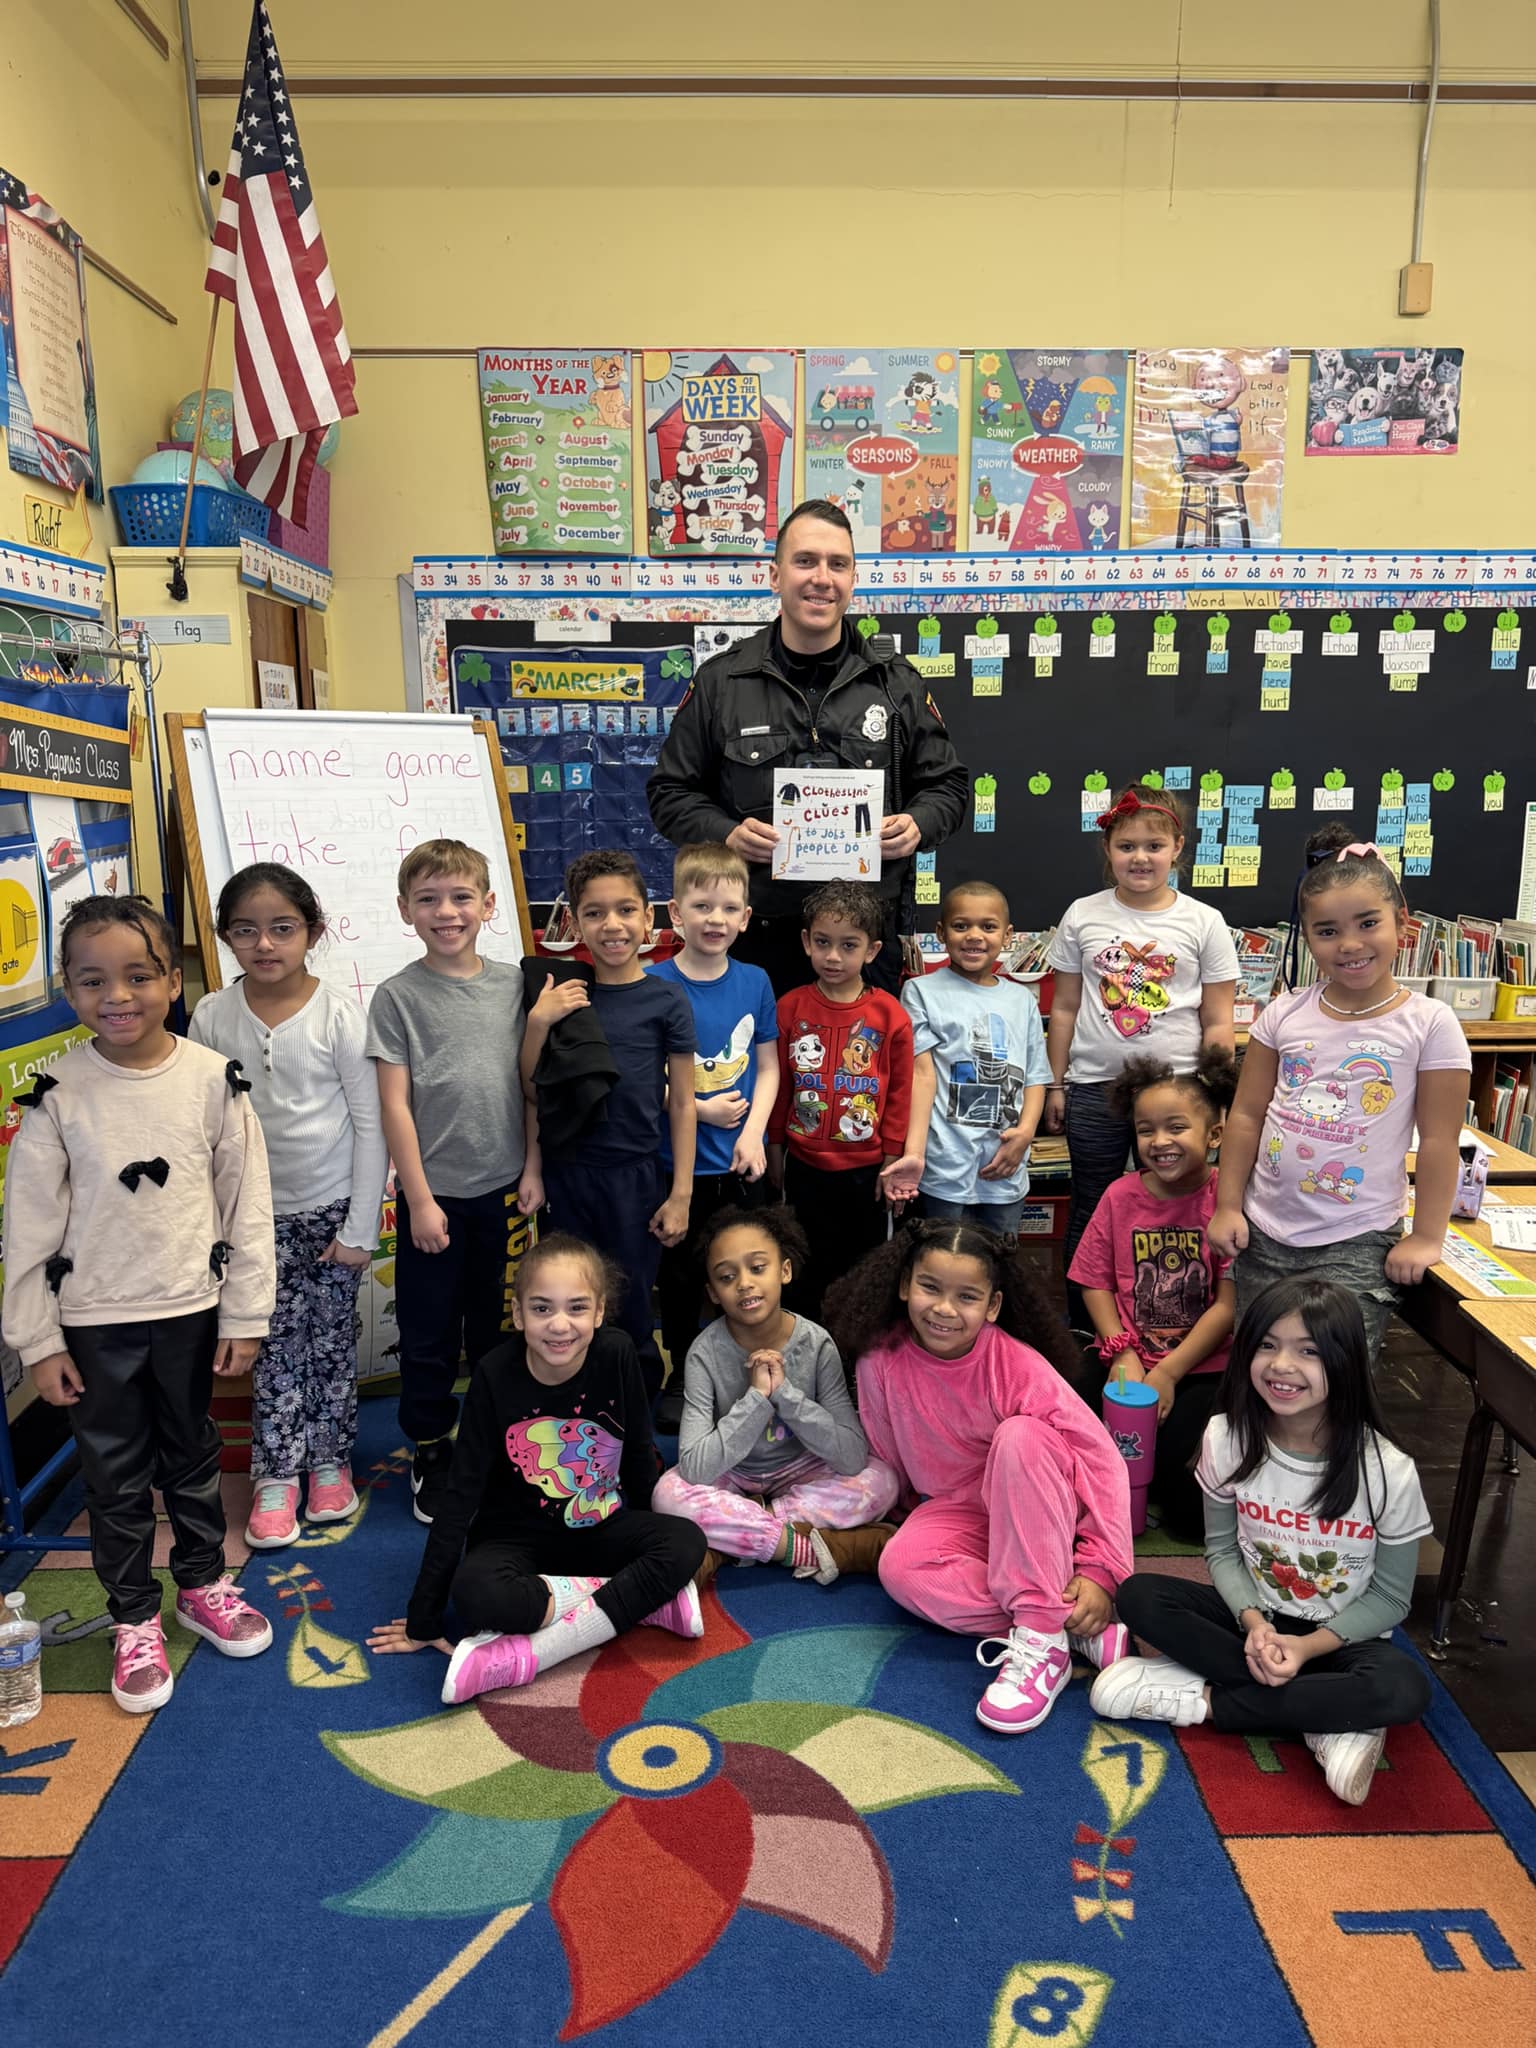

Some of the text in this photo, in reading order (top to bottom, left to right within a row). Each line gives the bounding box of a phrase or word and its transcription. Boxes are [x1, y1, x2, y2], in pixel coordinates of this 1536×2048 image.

[484, 355, 589, 371] MONTHS OF THE
[811, 356, 845, 367] SPRING
[888, 356, 929, 367] SUMMER
[1037, 356, 1071, 367] STORMY
[532, 375, 586, 395] YEAR
[687, 379, 736, 397] DAYS
[486, 392, 529, 404] January
[685, 395, 757, 420] WEEK
[492, 413, 541, 426] February
[564, 435, 607, 446] August
[700, 431, 743, 444] Sunday
[987, 428, 1015, 438] SUNNY
[491, 435, 526, 448] March
[1091, 441, 1115, 450] RAINY
[504, 455, 532, 468] April
[559, 456, 617, 468] September
[687, 448, 734, 464] Monday
[853, 447, 912, 464] SEASONS
[1019, 447, 1077, 463] WEATHER
[707, 464, 754, 477] Tuesday
[810, 459, 844, 470] WINTER
[931, 459, 951, 469] FALL
[978, 459, 1008, 469] SNOWY
[495, 481, 520, 495] May
[563, 477, 612, 489] October
[1079, 483, 1110, 493] CLOUDY
[687, 485, 741, 499] Wednesday
[506, 506, 534, 516] June
[560, 502, 617, 512] November
[713, 500, 760, 513] Thursday
[32, 503, 62, 548] Right
[699, 518, 734, 531] Friday
[500, 530, 520, 542] July
[559, 528, 620, 540] December
[710, 533, 758, 546] Saturday
[6, 567, 76, 597] 14 15 16 17 18
[420, 574, 765, 586] 33 34 35 36 37 38 39 40 41 42 43 44 45 46 47
[870, 567, 1517, 583] 52 53 54 55 56 57 58 59 60 61 62 63 64 65 66 67 68 69 70 71 72 73 74 75 76 77 78 79
[1187, 592, 1226, 608] Word
[1243, 592, 1278, 607] Wall
[174, 621, 201, 642] flag
[1031, 637, 1061, 654] David
[1157, 635, 1171, 653] for
[1149, 655, 1178, 672] from
[1493, 651, 1514, 667] look
[534, 671, 616, 692] MARCH
[9, 727, 41, 773] Mrs.
[85, 743, 119, 779] Class
[228, 748, 481, 807] name game
[540, 769, 583, 787] 4 5
[1166, 769, 1191, 787] start
[1226, 789, 1261, 806] there
[1270, 796, 1295, 808] upon
[1315, 790, 1352, 808] Victor
[1379, 810, 1404, 825] what
[238, 810, 346, 866] take
[805, 827, 817, 836] to
[1229, 828, 1257, 843] them
[1197, 846, 1219, 863] this
[1407, 858, 1429, 874] why
[1194, 868, 1222, 884] that
[2, 959, 19, 974] gate
[794, 1072, 880, 1094] OOL PUPS
[1302, 1128, 1354, 1144] FRIENDS
[1319, 1120, 1369, 1136] KITTY
[1259, 1526, 1337, 1548] ITALIAN MARKET
[1317, 1518, 1376, 1540] VITA
[1100, 1741, 1144, 1788] 7
[1332, 1907, 1526, 1974] F
[1011, 1974, 1087, 2038] 8
